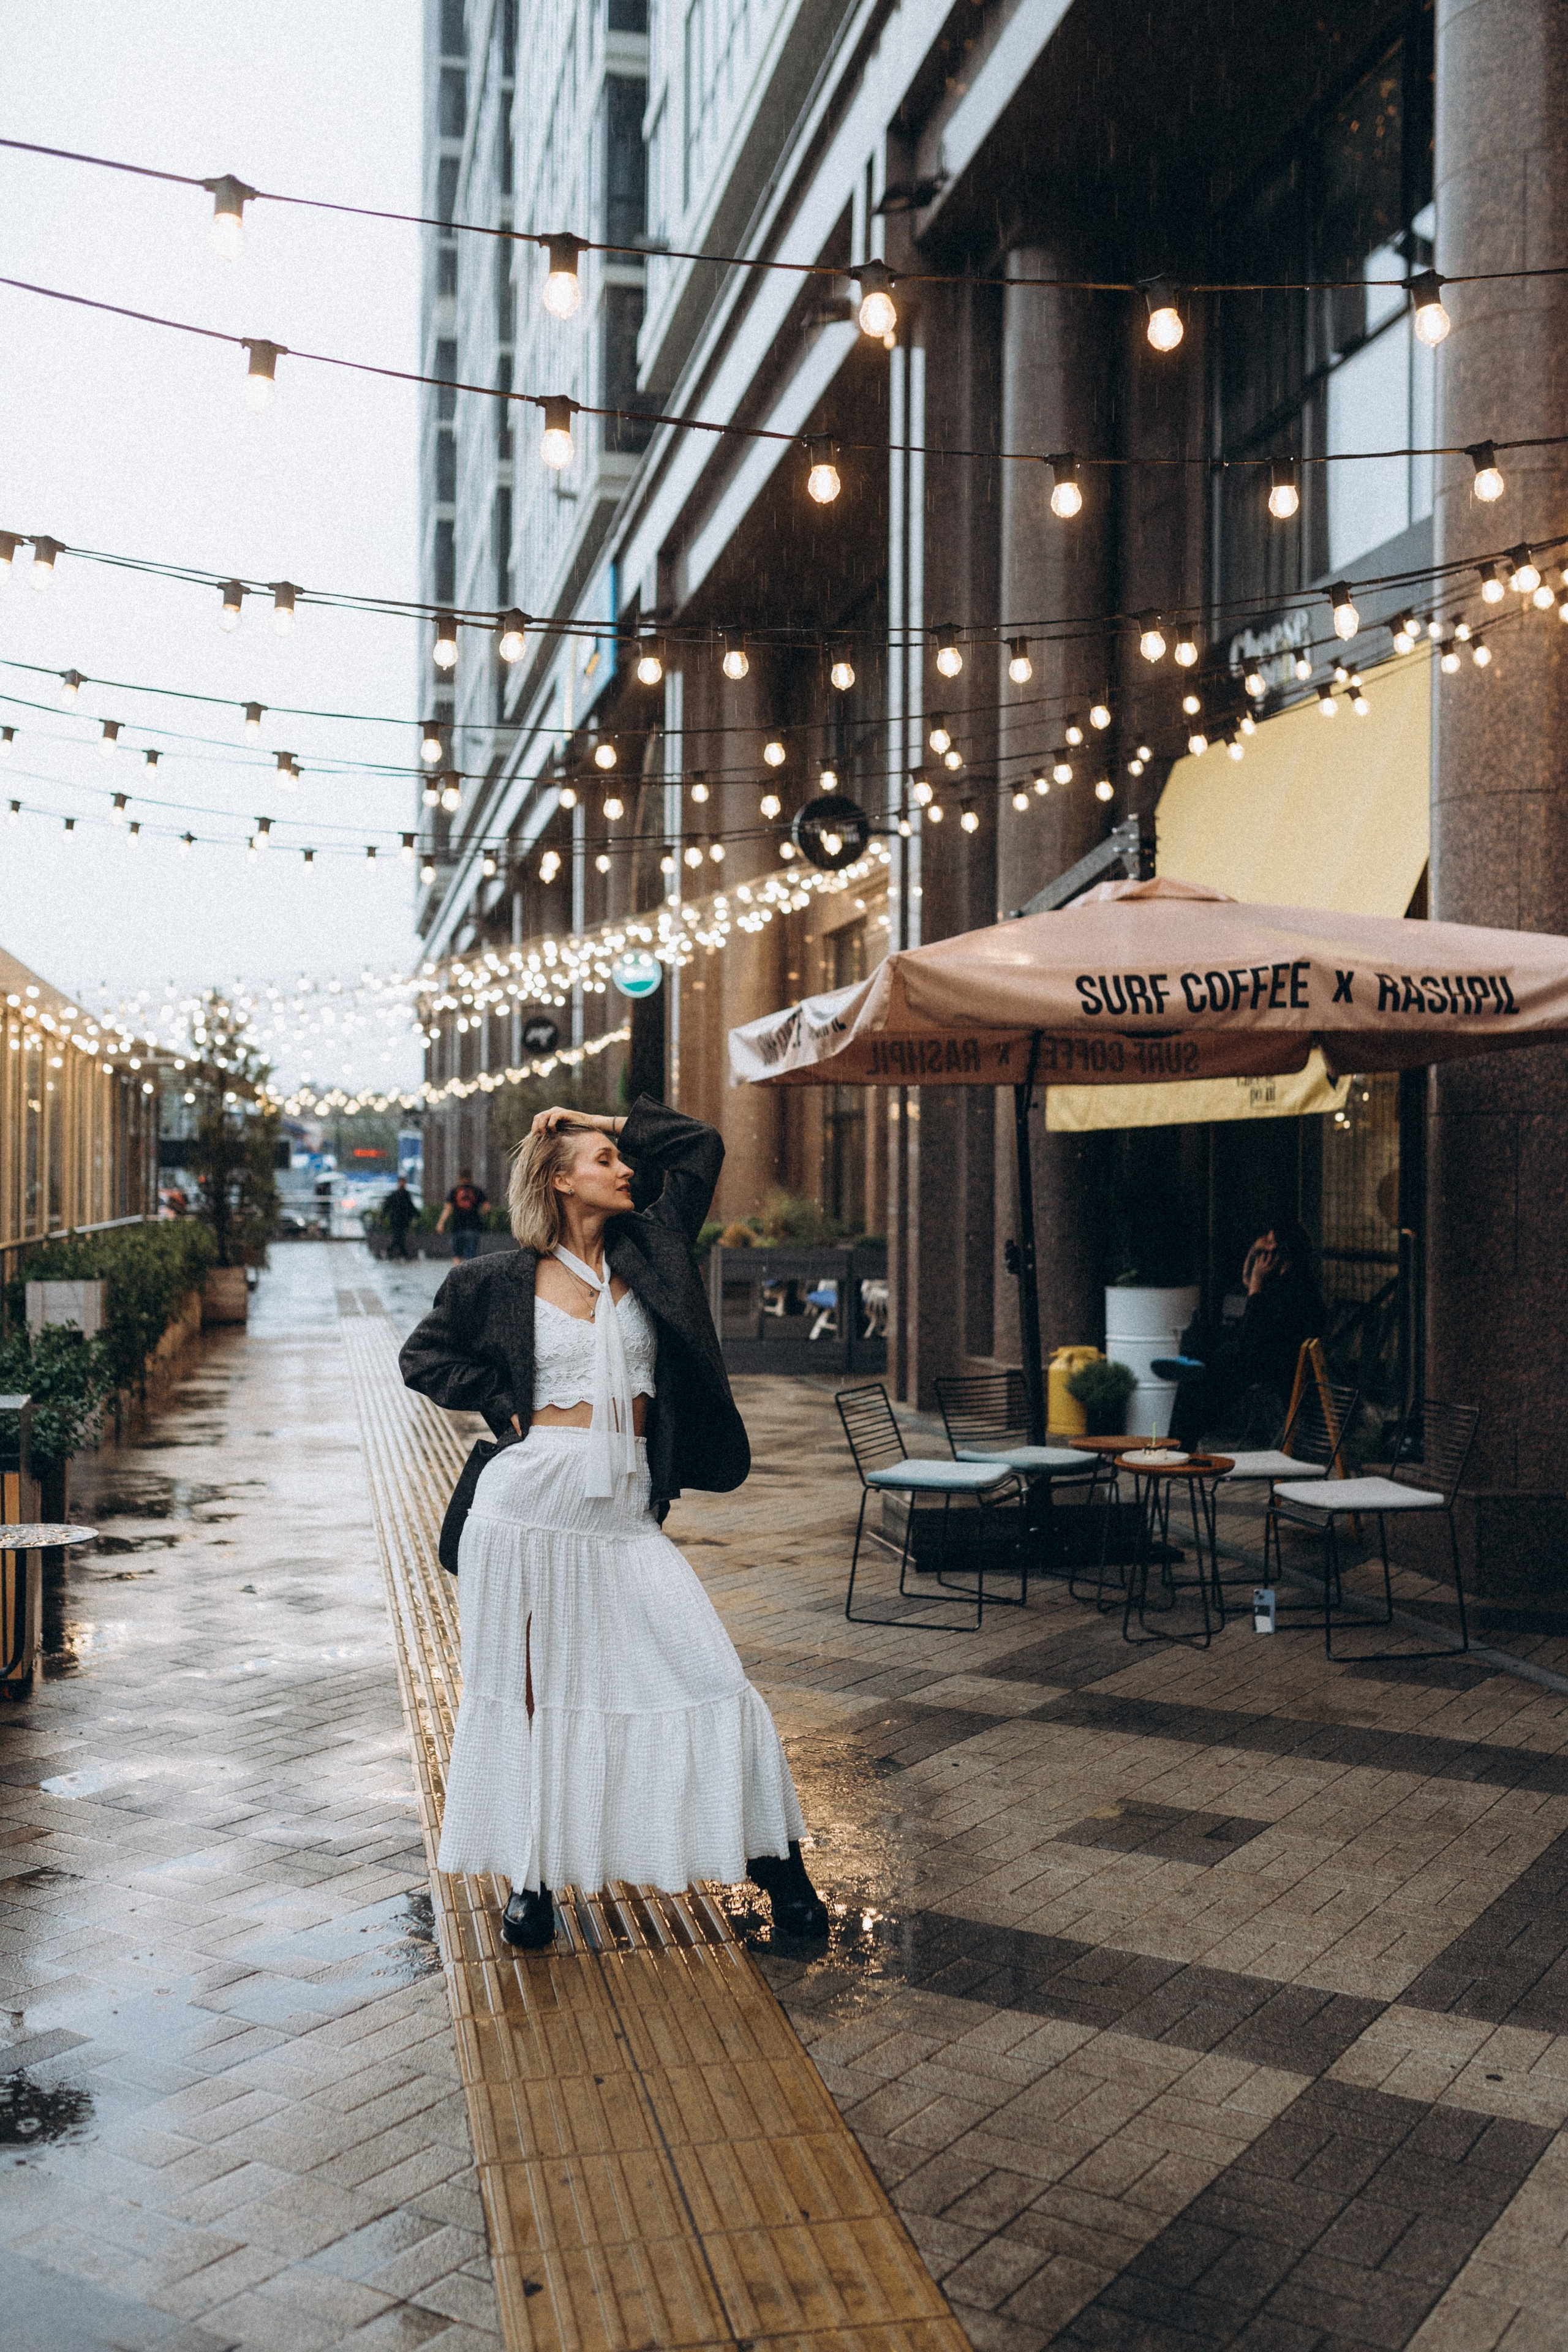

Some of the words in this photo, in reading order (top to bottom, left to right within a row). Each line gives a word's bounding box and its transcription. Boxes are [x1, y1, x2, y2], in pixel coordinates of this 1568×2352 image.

[1076, 974, 1170, 1016] SURF
[1180, 962, 1311, 1013] COFFEE
[1374, 973, 1520, 1014] RASHPIL
